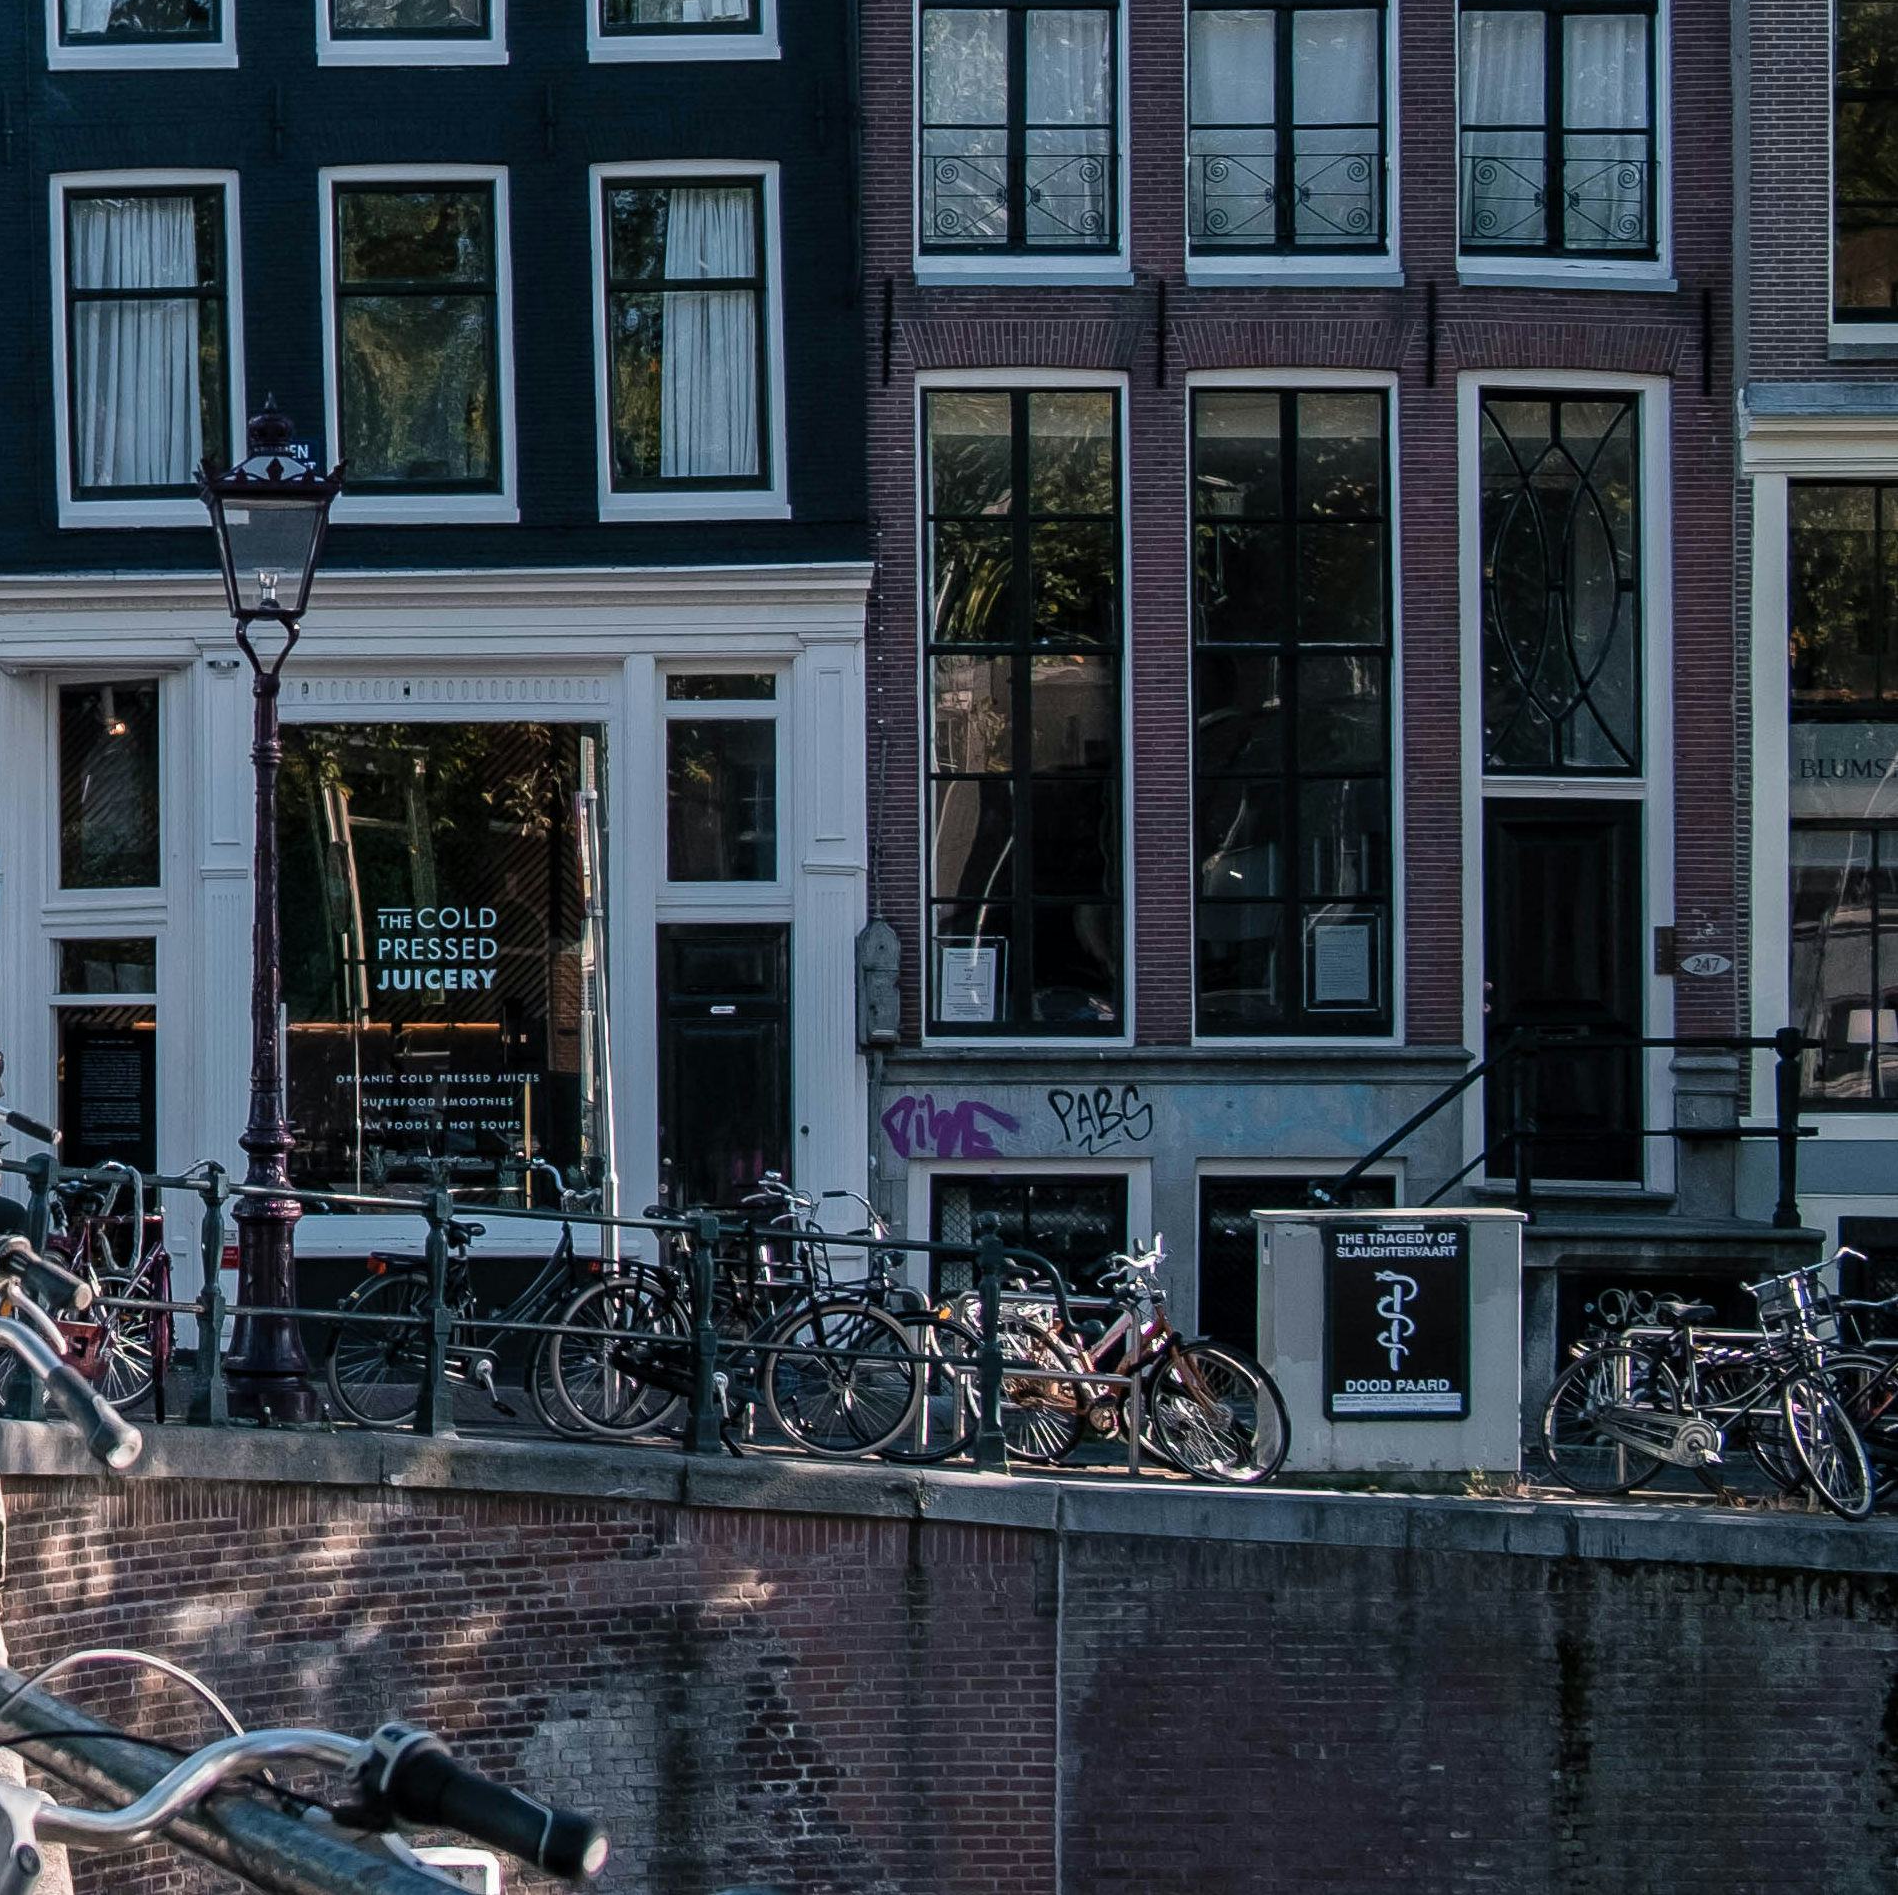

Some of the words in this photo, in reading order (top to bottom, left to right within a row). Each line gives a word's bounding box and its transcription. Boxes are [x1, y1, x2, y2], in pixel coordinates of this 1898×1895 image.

[377, 915, 412, 929] THE
[417, 907, 497, 929] COLD
[378, 937, 498, 960] PRESSED
[1692, 957, 1721, 972] 247
[376, 969, 497, 991] JUICERY
[336, 1074, 394, 1084] ORGANIC
[399, 1074, 433, 1083] COLD
[439, 1074, 491, 1083] PRESSED
[497, 1073, 541, 1083] JUICES
[361, 1097, 436, 1108] SUPERFOOD
[442, 1096, 514, 1106] SMOOTHIES
[387, 1120, 430, 1130] FOODS
[449, 1120, 475, 1130] HOT
[480, 1119, 521, 1130] SOUPS
[1336, 1233, 1364, 1245] THE
[1367, 1233, 1434, 1244] TRAGEDY
[1437, 1232, 1457, 1244] OF
[1336, 1246, 1458, 1258] SLAUGHTERVAART
[1345, 1380, 1392, 1392] DOOD
[1395, 1379, 1450, 1392] PAARD
